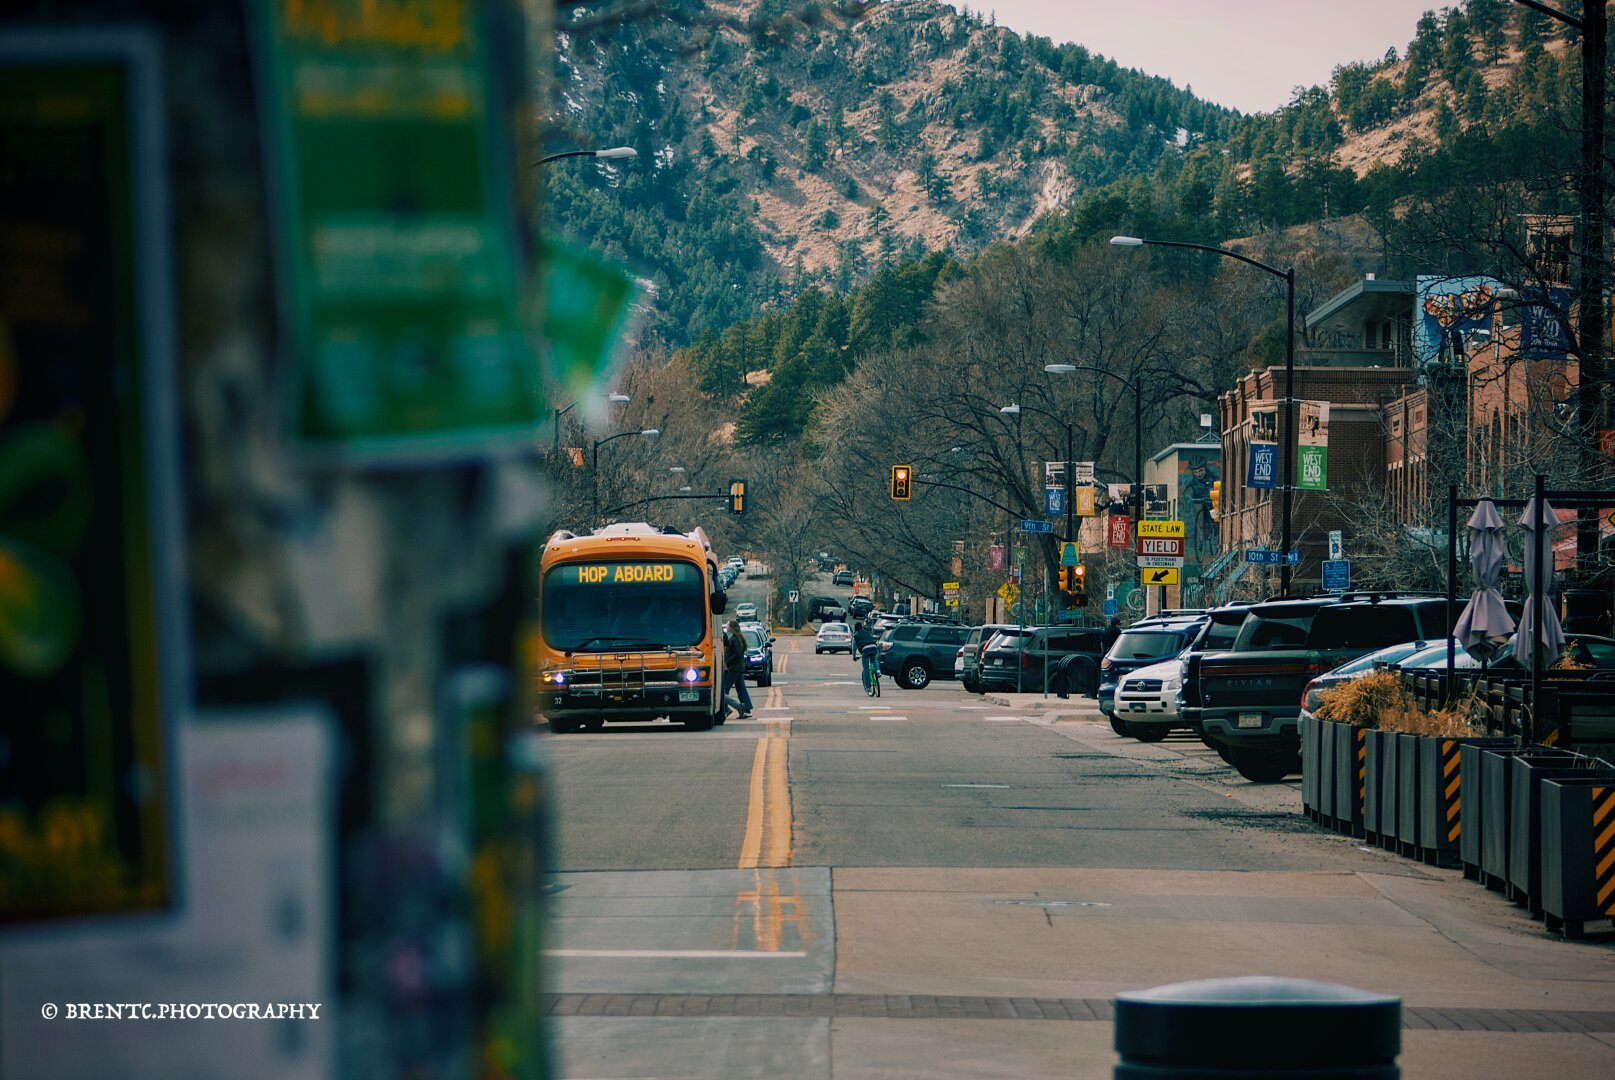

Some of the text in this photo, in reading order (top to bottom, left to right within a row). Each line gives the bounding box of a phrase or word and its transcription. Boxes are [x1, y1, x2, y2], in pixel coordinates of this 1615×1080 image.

[1255, 452, 1272, 464] WEST
[1302, 454, 1322, 465] WEST
[1255, 464, 1271, 476] END
[1303, 465, 1321, 477] END
[1049, 493, 1061, 501] WEST
[1049, 500, 1060, 508] END
[1024, 522, 1036, 530] 9th
[1112, 521, 1126, 531] WEST
[1142, 525, 1181, 533] STATE LAW
[1112, 531, 1125, 540] END
[1145, 540, 1178, 552] YIELD
[1248, 552, 1264, 561] 10th
[1271, 552, 1279, 561] St
[579, 565, 674, 583] HOP ABOARD
[1226, 678, 1272, 687] RIVIAN
[554, 697, 562, 705] 32
